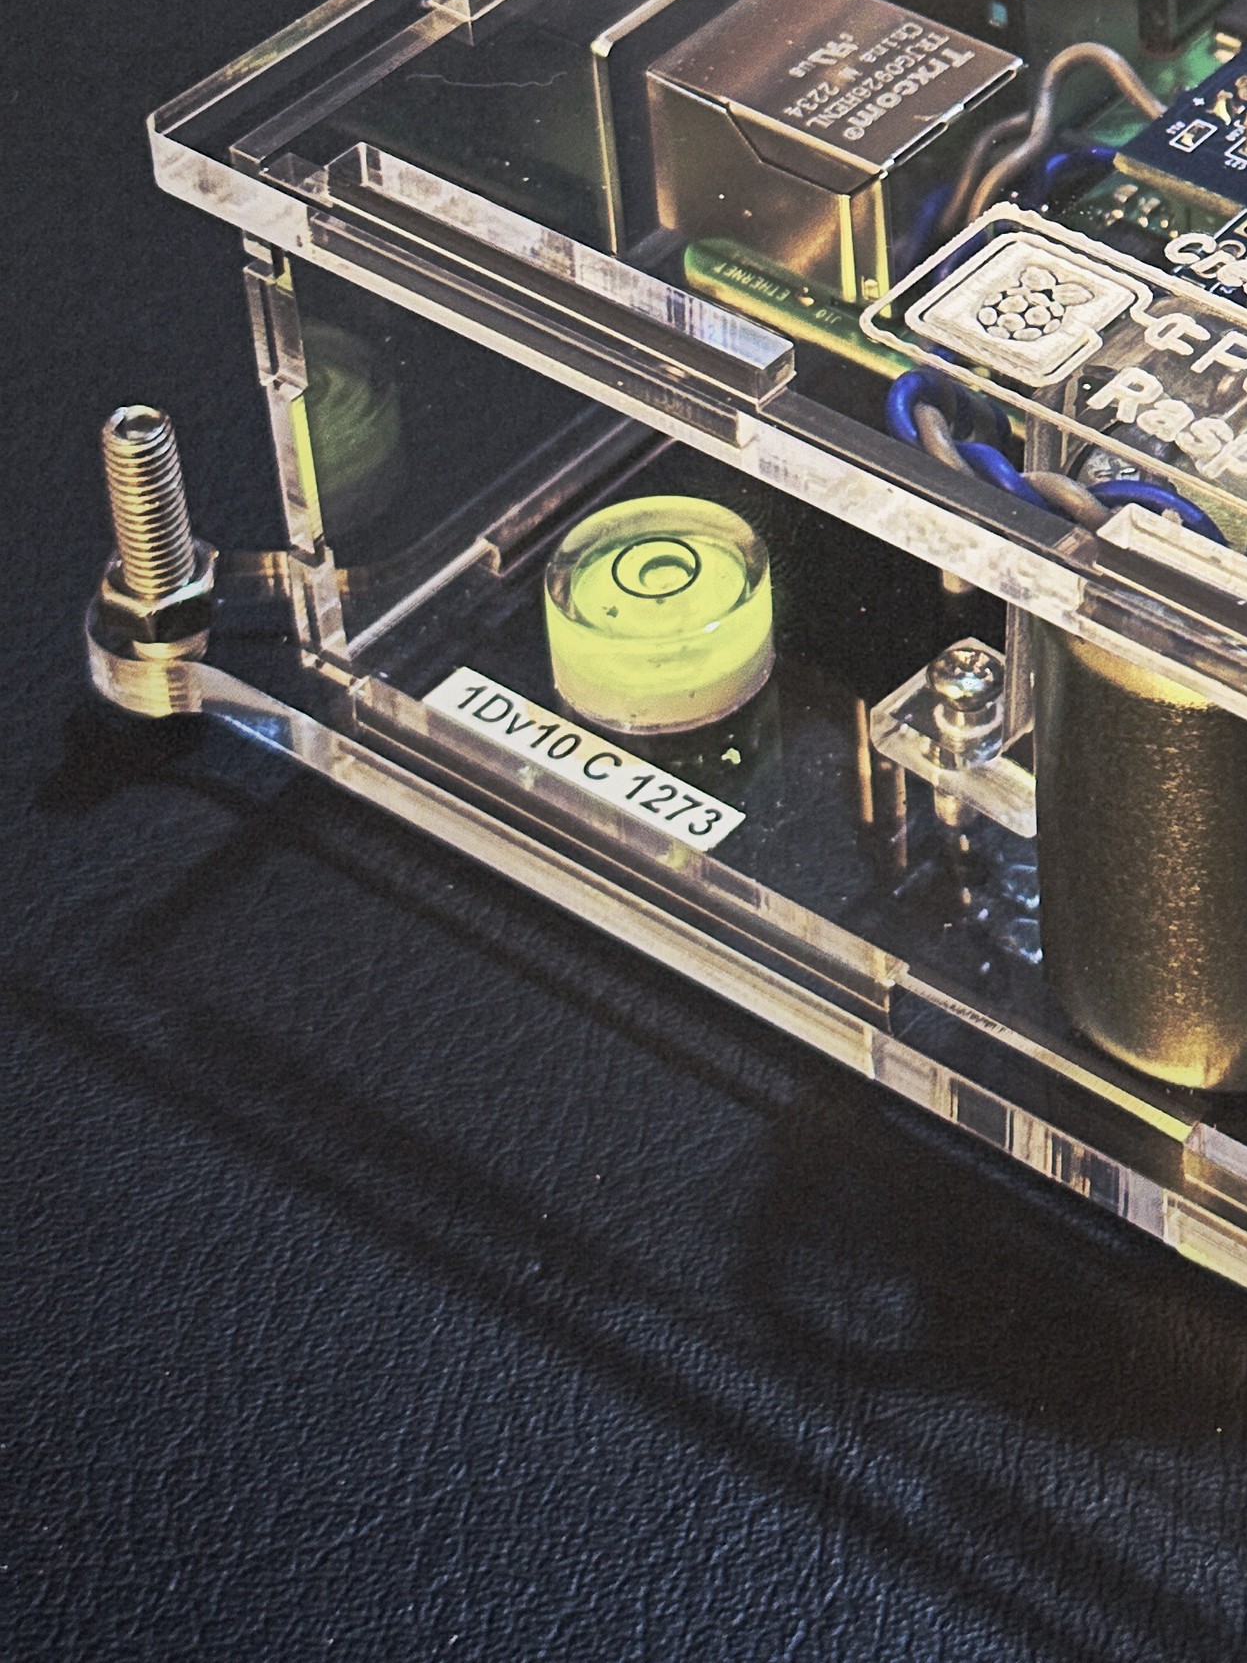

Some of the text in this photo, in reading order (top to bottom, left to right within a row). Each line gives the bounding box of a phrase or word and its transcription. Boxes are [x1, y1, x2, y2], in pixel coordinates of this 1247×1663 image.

[783, 80, 841, 119] 2234
[712, 262, 791, 302] ETHERNET
[457, 685, 724, 837] 1Dv10 C 1273
